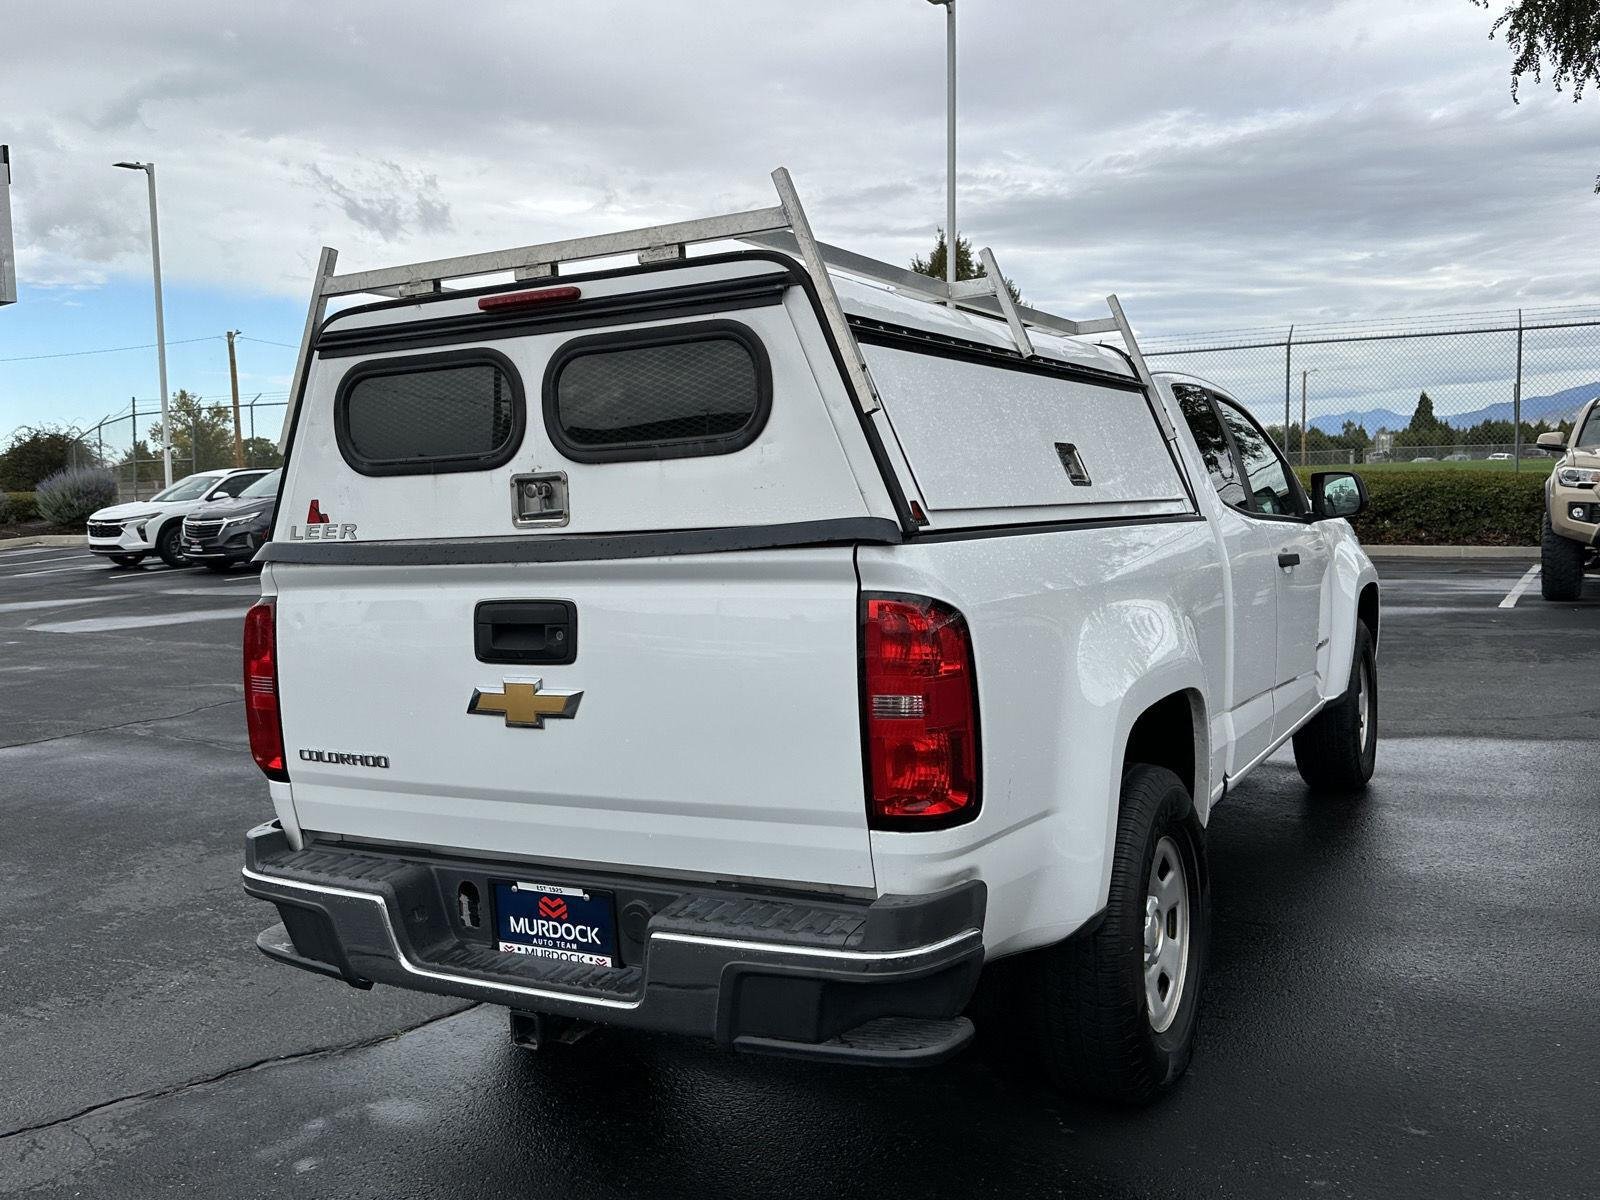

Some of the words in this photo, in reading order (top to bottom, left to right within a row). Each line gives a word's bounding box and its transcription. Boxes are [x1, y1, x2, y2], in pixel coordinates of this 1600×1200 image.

[290, 524, 358, 541] LEER
[299, 749, 390, 769] COLORADO
[509, 915, 602, 945] MURDOCK
[532, 937, 554, 947] AUTO
[556, 940, 578, 950] TEAM
[525, 947, 585, 963] MURDOCK
